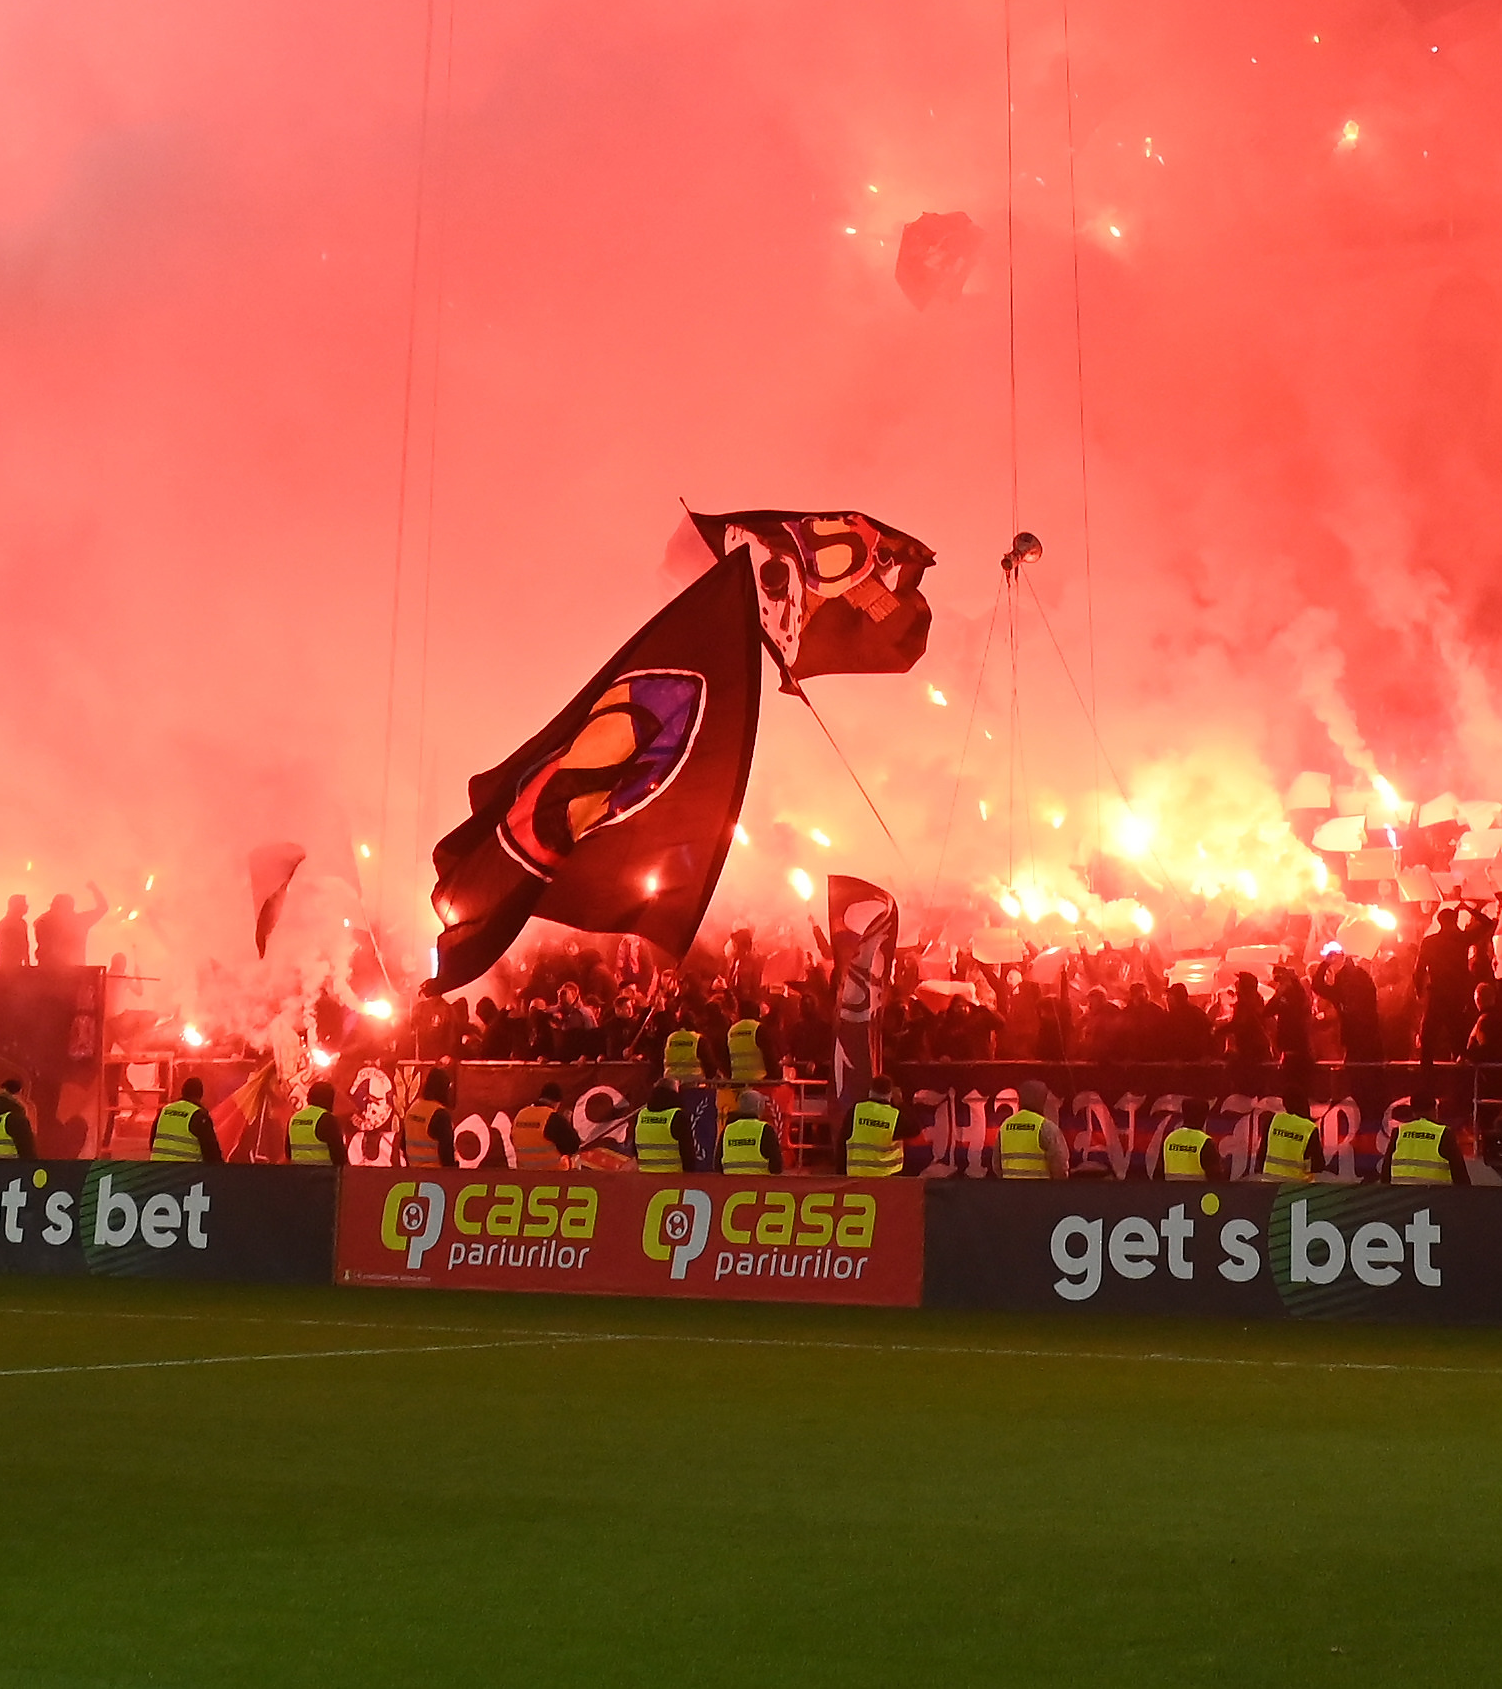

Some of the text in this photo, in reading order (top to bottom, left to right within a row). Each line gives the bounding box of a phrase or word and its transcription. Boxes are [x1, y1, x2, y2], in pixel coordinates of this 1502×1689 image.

[92, 1173, 212, 1249] bet
[453, 1185, 598, 1239] casa
[721, 1190, 876, 1248] casa
[448, 1240, 590, 1271] pariurilor
[715, 1248, 868, 1282] pariurilor
[1290, 1200, 1442, 1287] bet
